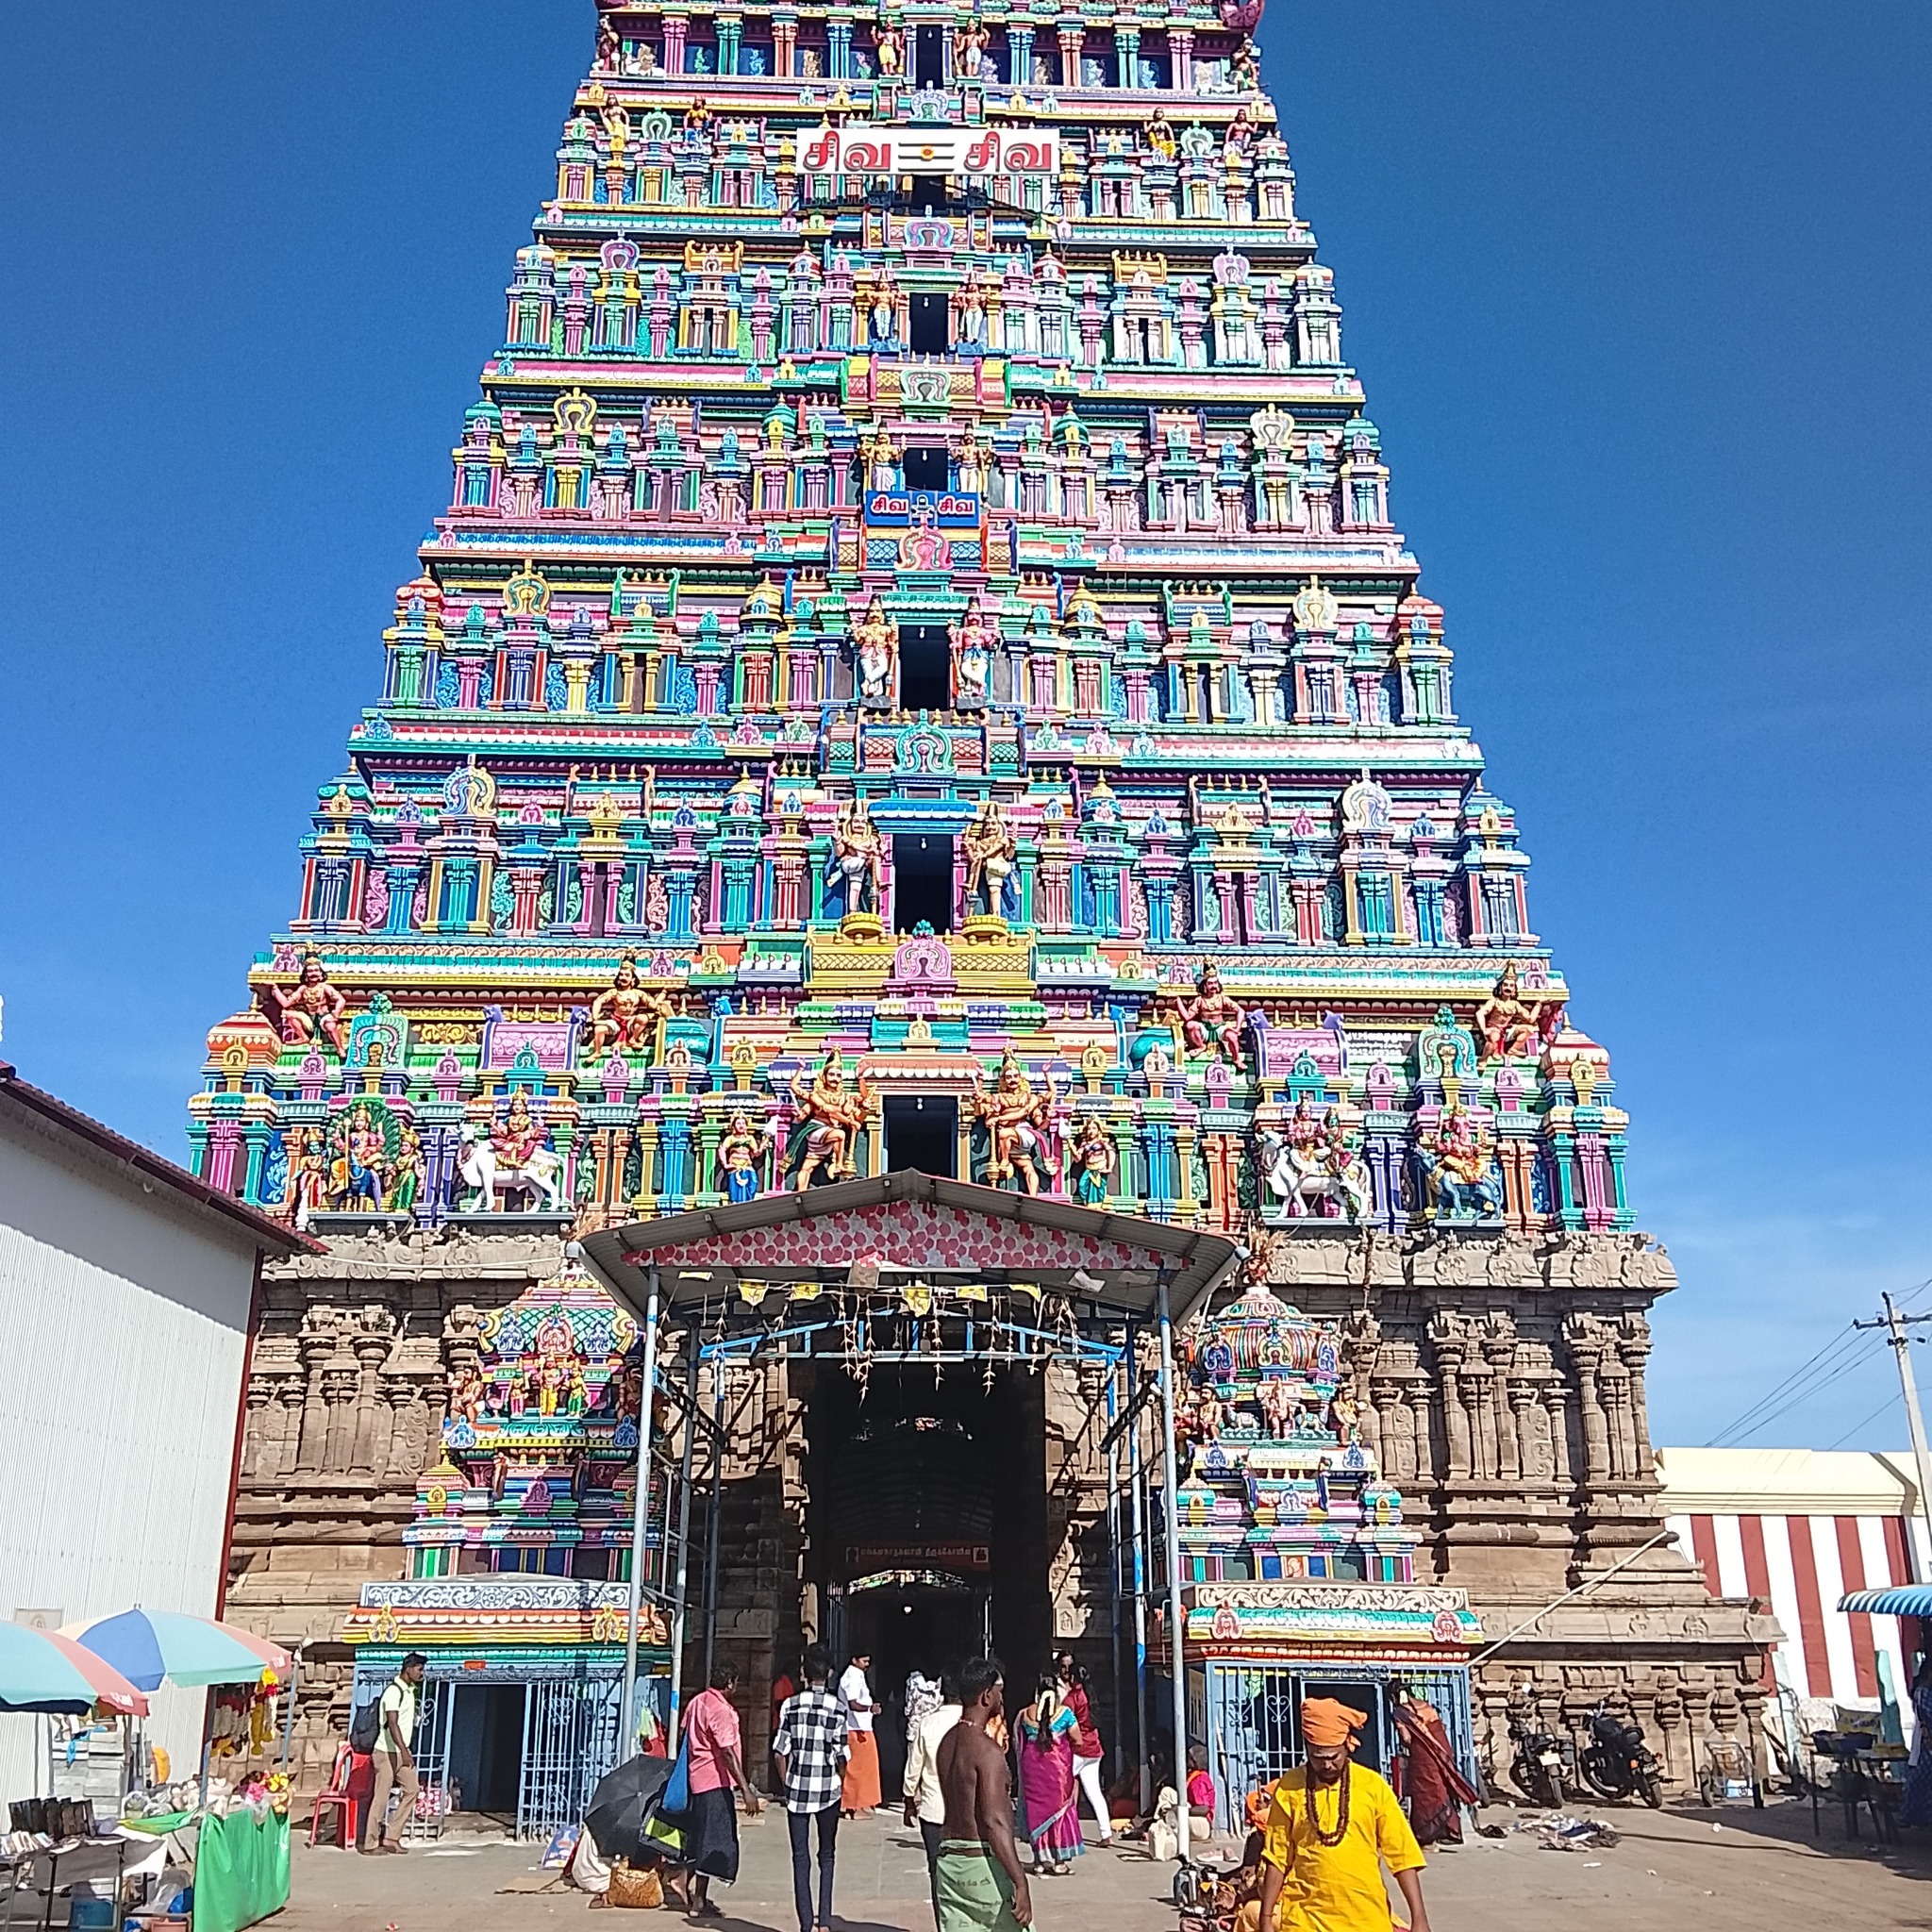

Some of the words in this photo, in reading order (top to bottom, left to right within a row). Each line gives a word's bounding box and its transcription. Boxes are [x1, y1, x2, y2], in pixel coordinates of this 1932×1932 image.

[803, 130, 891, 172] சிவ
[964, 130, 1052, 172] சிவ
[872, 495, 908, 513] சிவ
[939, 495, 975, 514] சிவ
